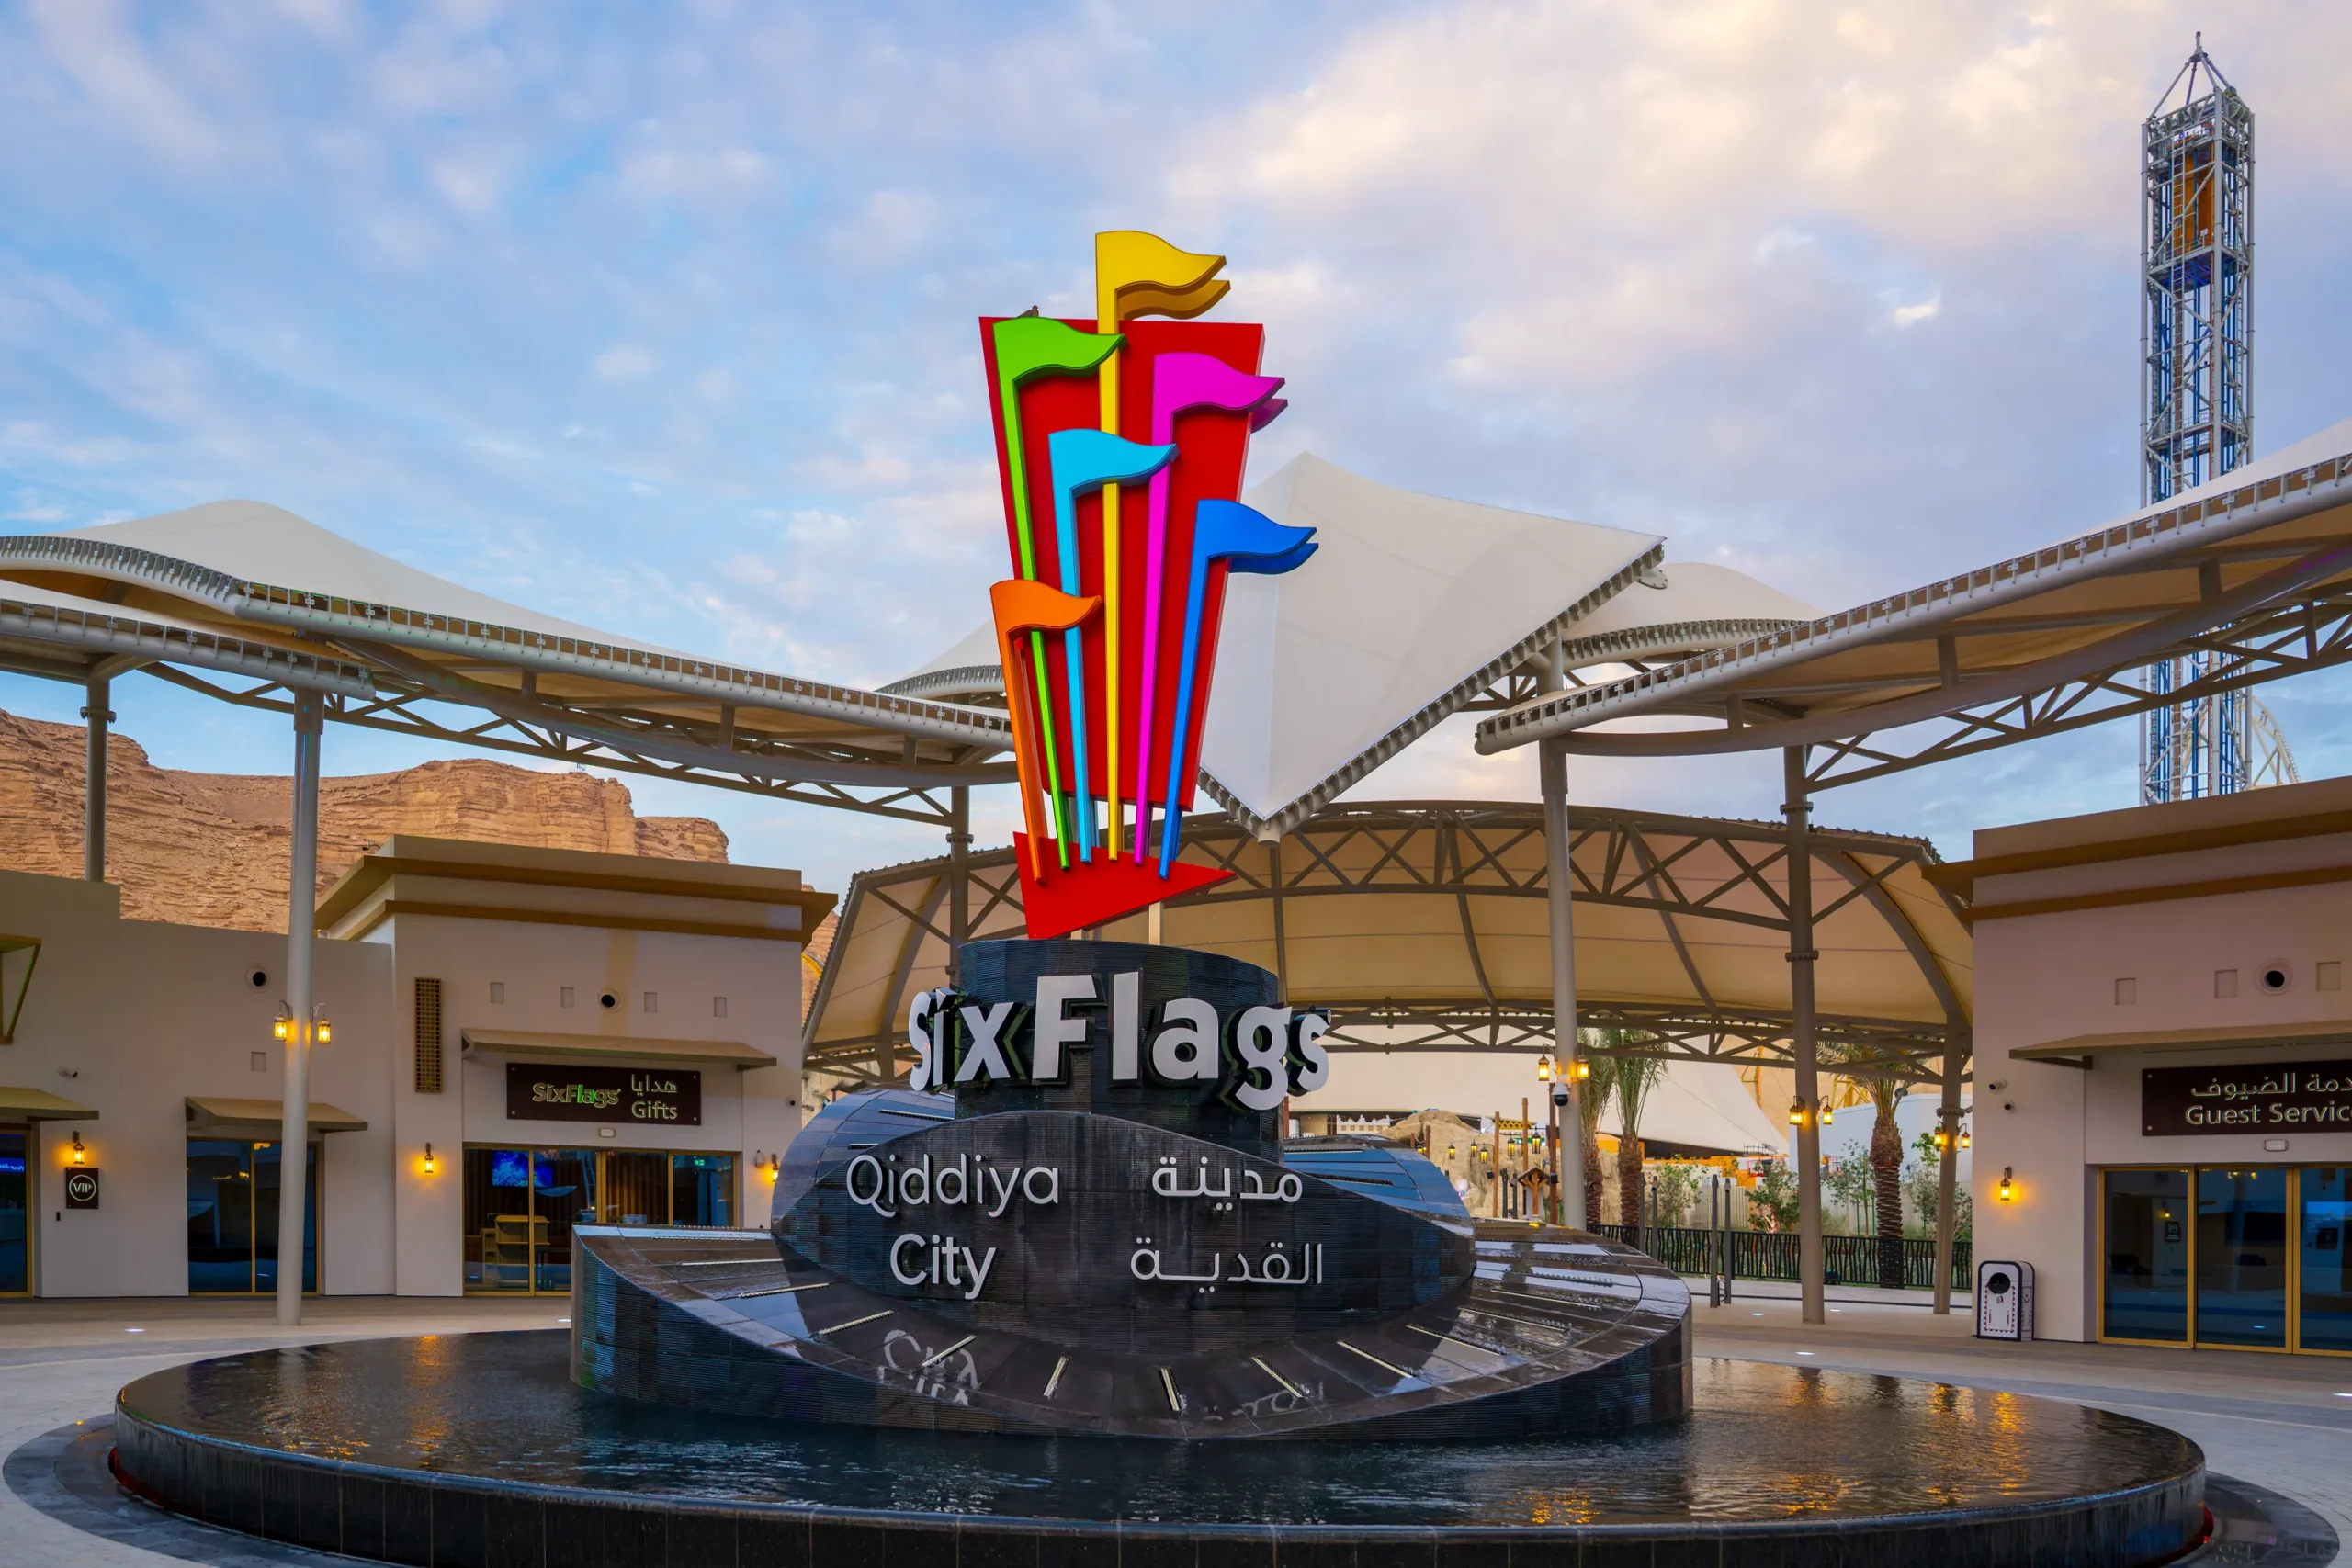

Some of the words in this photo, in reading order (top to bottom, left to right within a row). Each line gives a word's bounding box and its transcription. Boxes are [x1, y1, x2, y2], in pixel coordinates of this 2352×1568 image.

[908, 970, 1330, 1111] SixFlags
[631, 1074, 678, 1097] هدايا
[2190, 1072, 2296, 1100] الضيوف
[2305, 1073, 2352, 1092] دمة
[631, 1100, 678, 1120] Gifts
[2185, 1104, 2261, 1125] Guest
[2269, 1100, 2352, 1123] Servic
[73, 1182, 93, 1193] VIP
[846, 1154, 1059, 1218] Qiddiya
[1152, 1156, 1303, 1211] مدينة
[889, 1233, 997, 1301] City
[1130, 1237, 1323, 1293] القدية
